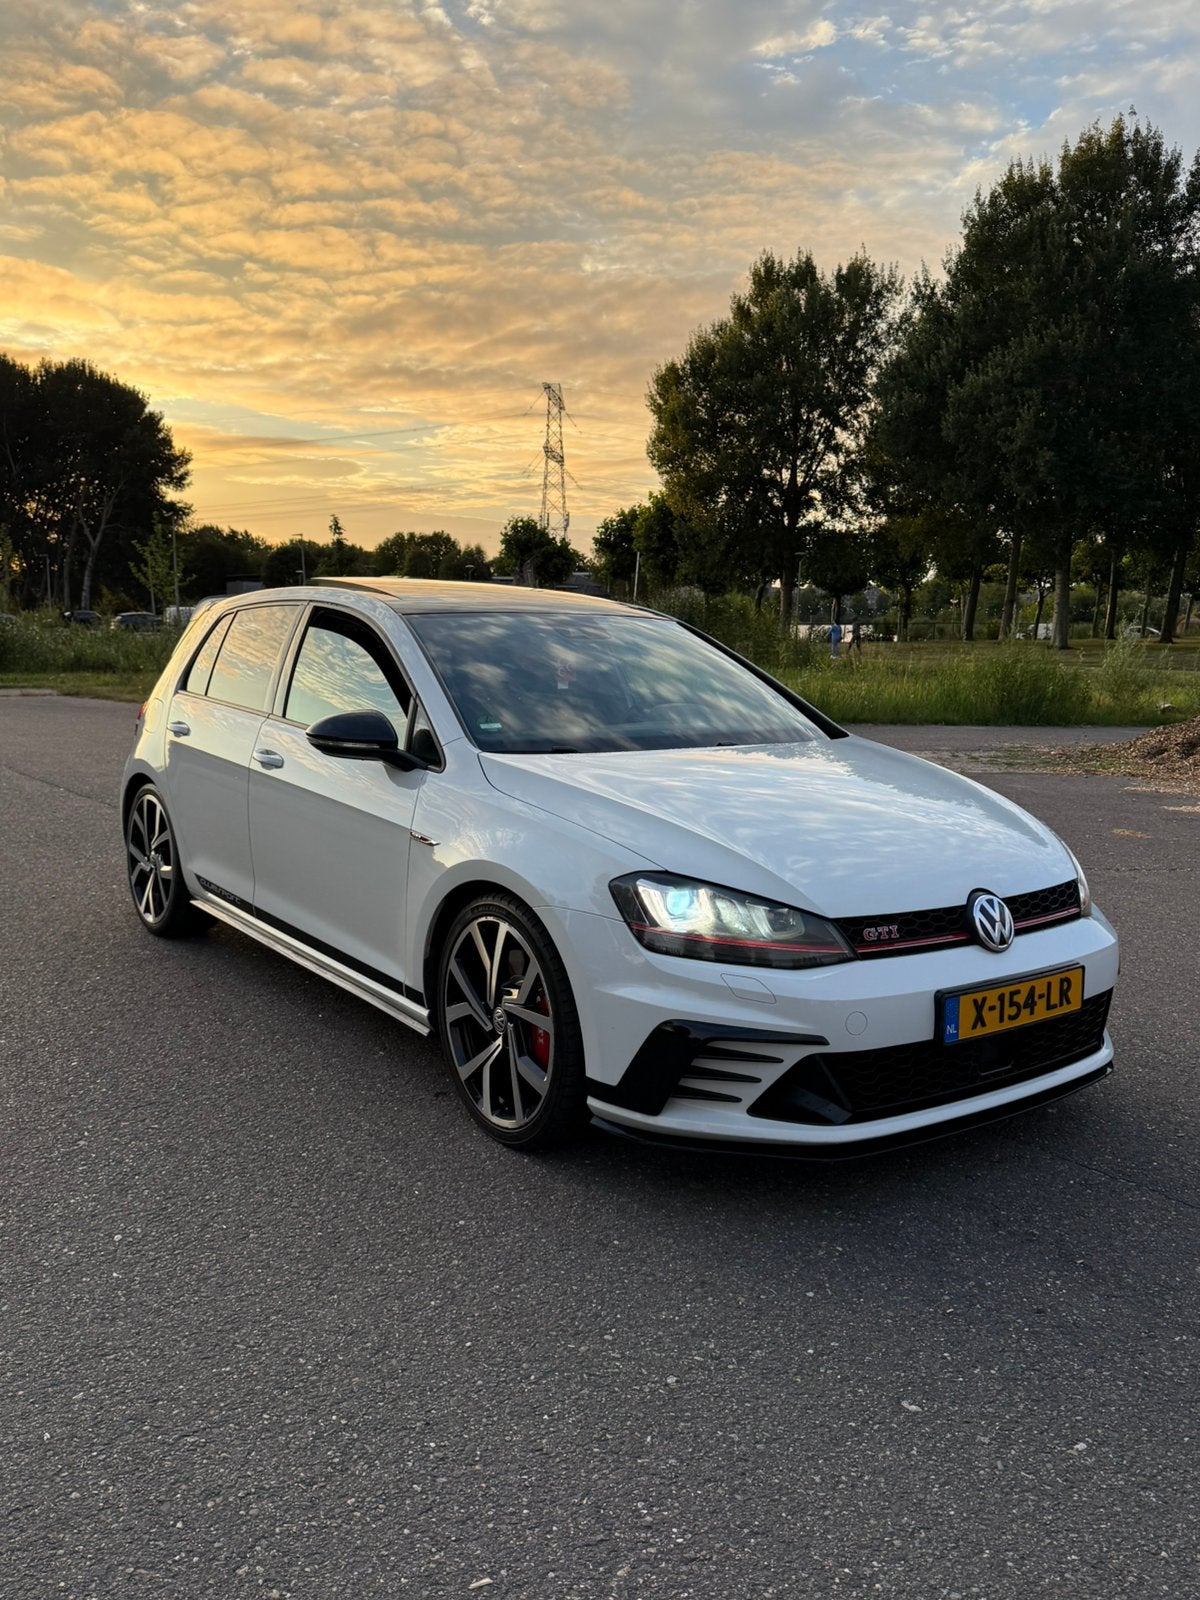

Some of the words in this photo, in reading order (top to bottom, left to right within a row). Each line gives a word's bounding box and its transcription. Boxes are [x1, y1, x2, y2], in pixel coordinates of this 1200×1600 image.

[863, 924, 900, 941] GTI
[971, 976, 1072, 1031] X-154-LR
[946, 1024, 958, 1035] NL
